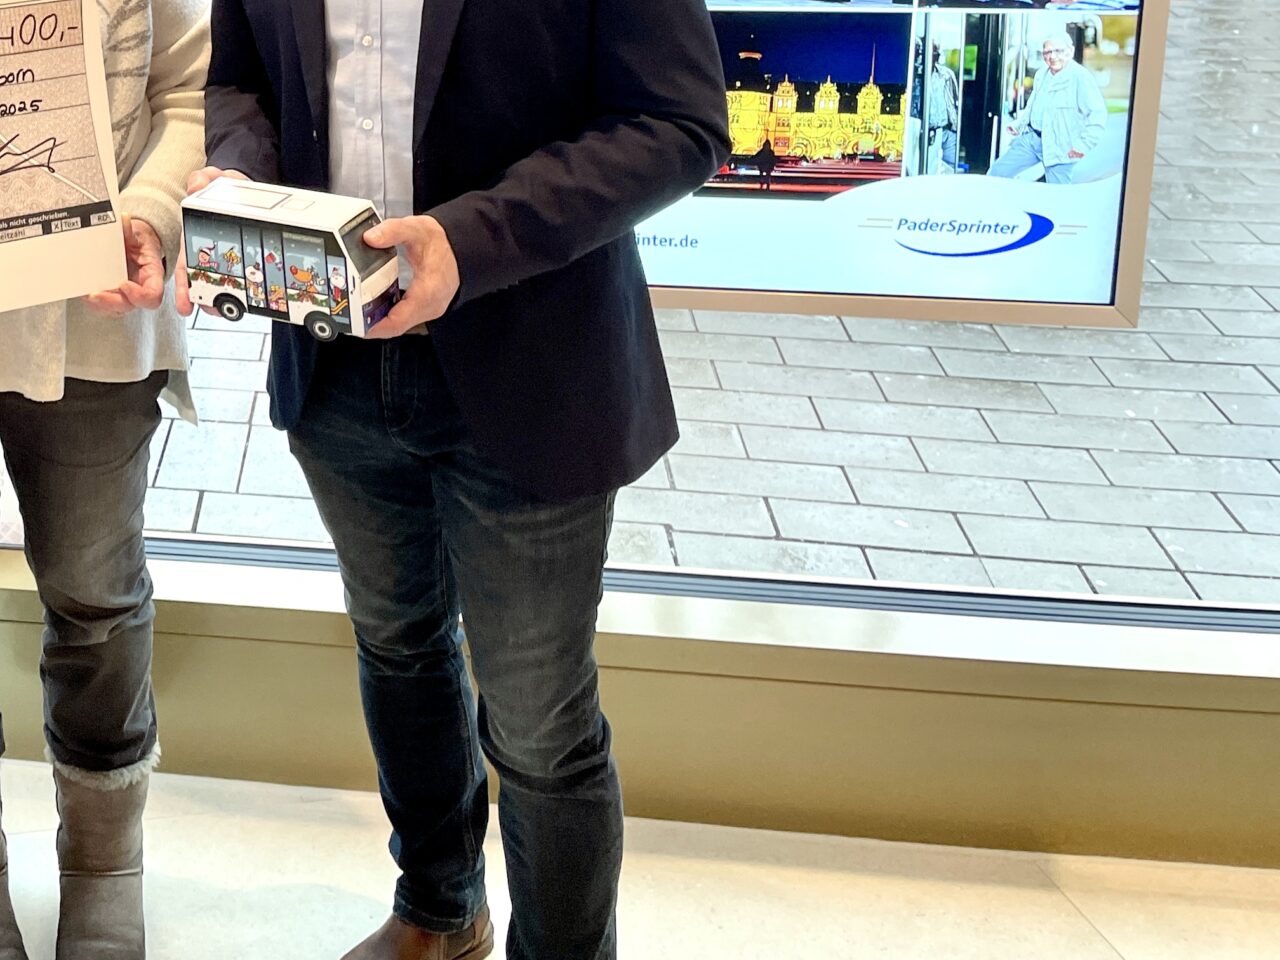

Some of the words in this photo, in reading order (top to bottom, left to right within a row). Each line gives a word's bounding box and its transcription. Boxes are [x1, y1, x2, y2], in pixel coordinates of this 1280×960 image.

[9, 217, 26, 228] nicht
[28, 210, 70, 225] geschrieben.
[896, 217, 1019, 237] PaderSprinter
